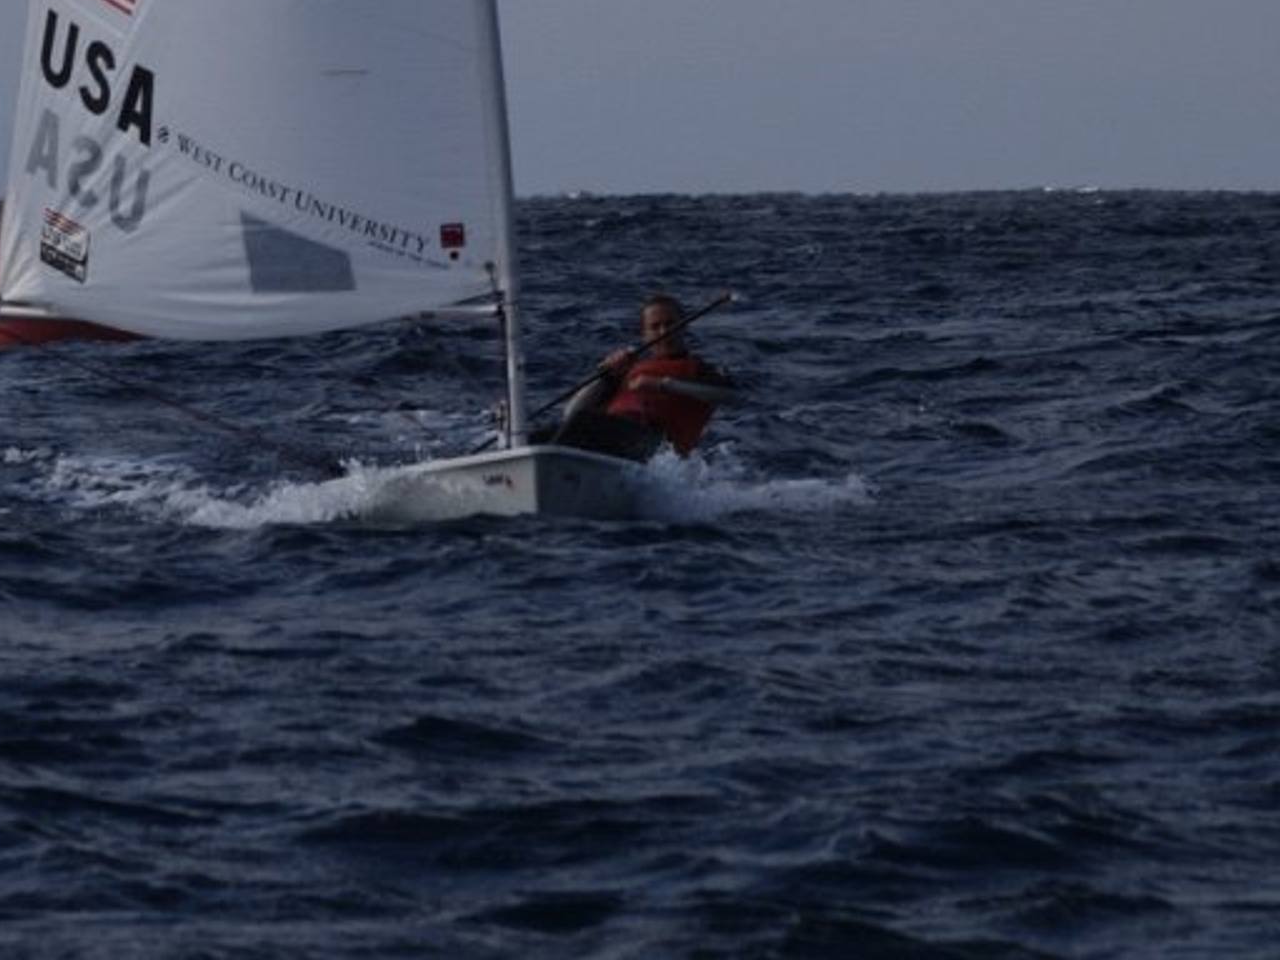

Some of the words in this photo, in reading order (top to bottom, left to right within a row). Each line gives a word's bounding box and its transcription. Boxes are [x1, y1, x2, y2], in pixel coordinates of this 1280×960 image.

[40, 9, 154, 147] USA
[177, 133, 225, 173] WEST
[228, 160, 293, 204] COAST
[294, 190, 431, 253] UNIVERSITY
